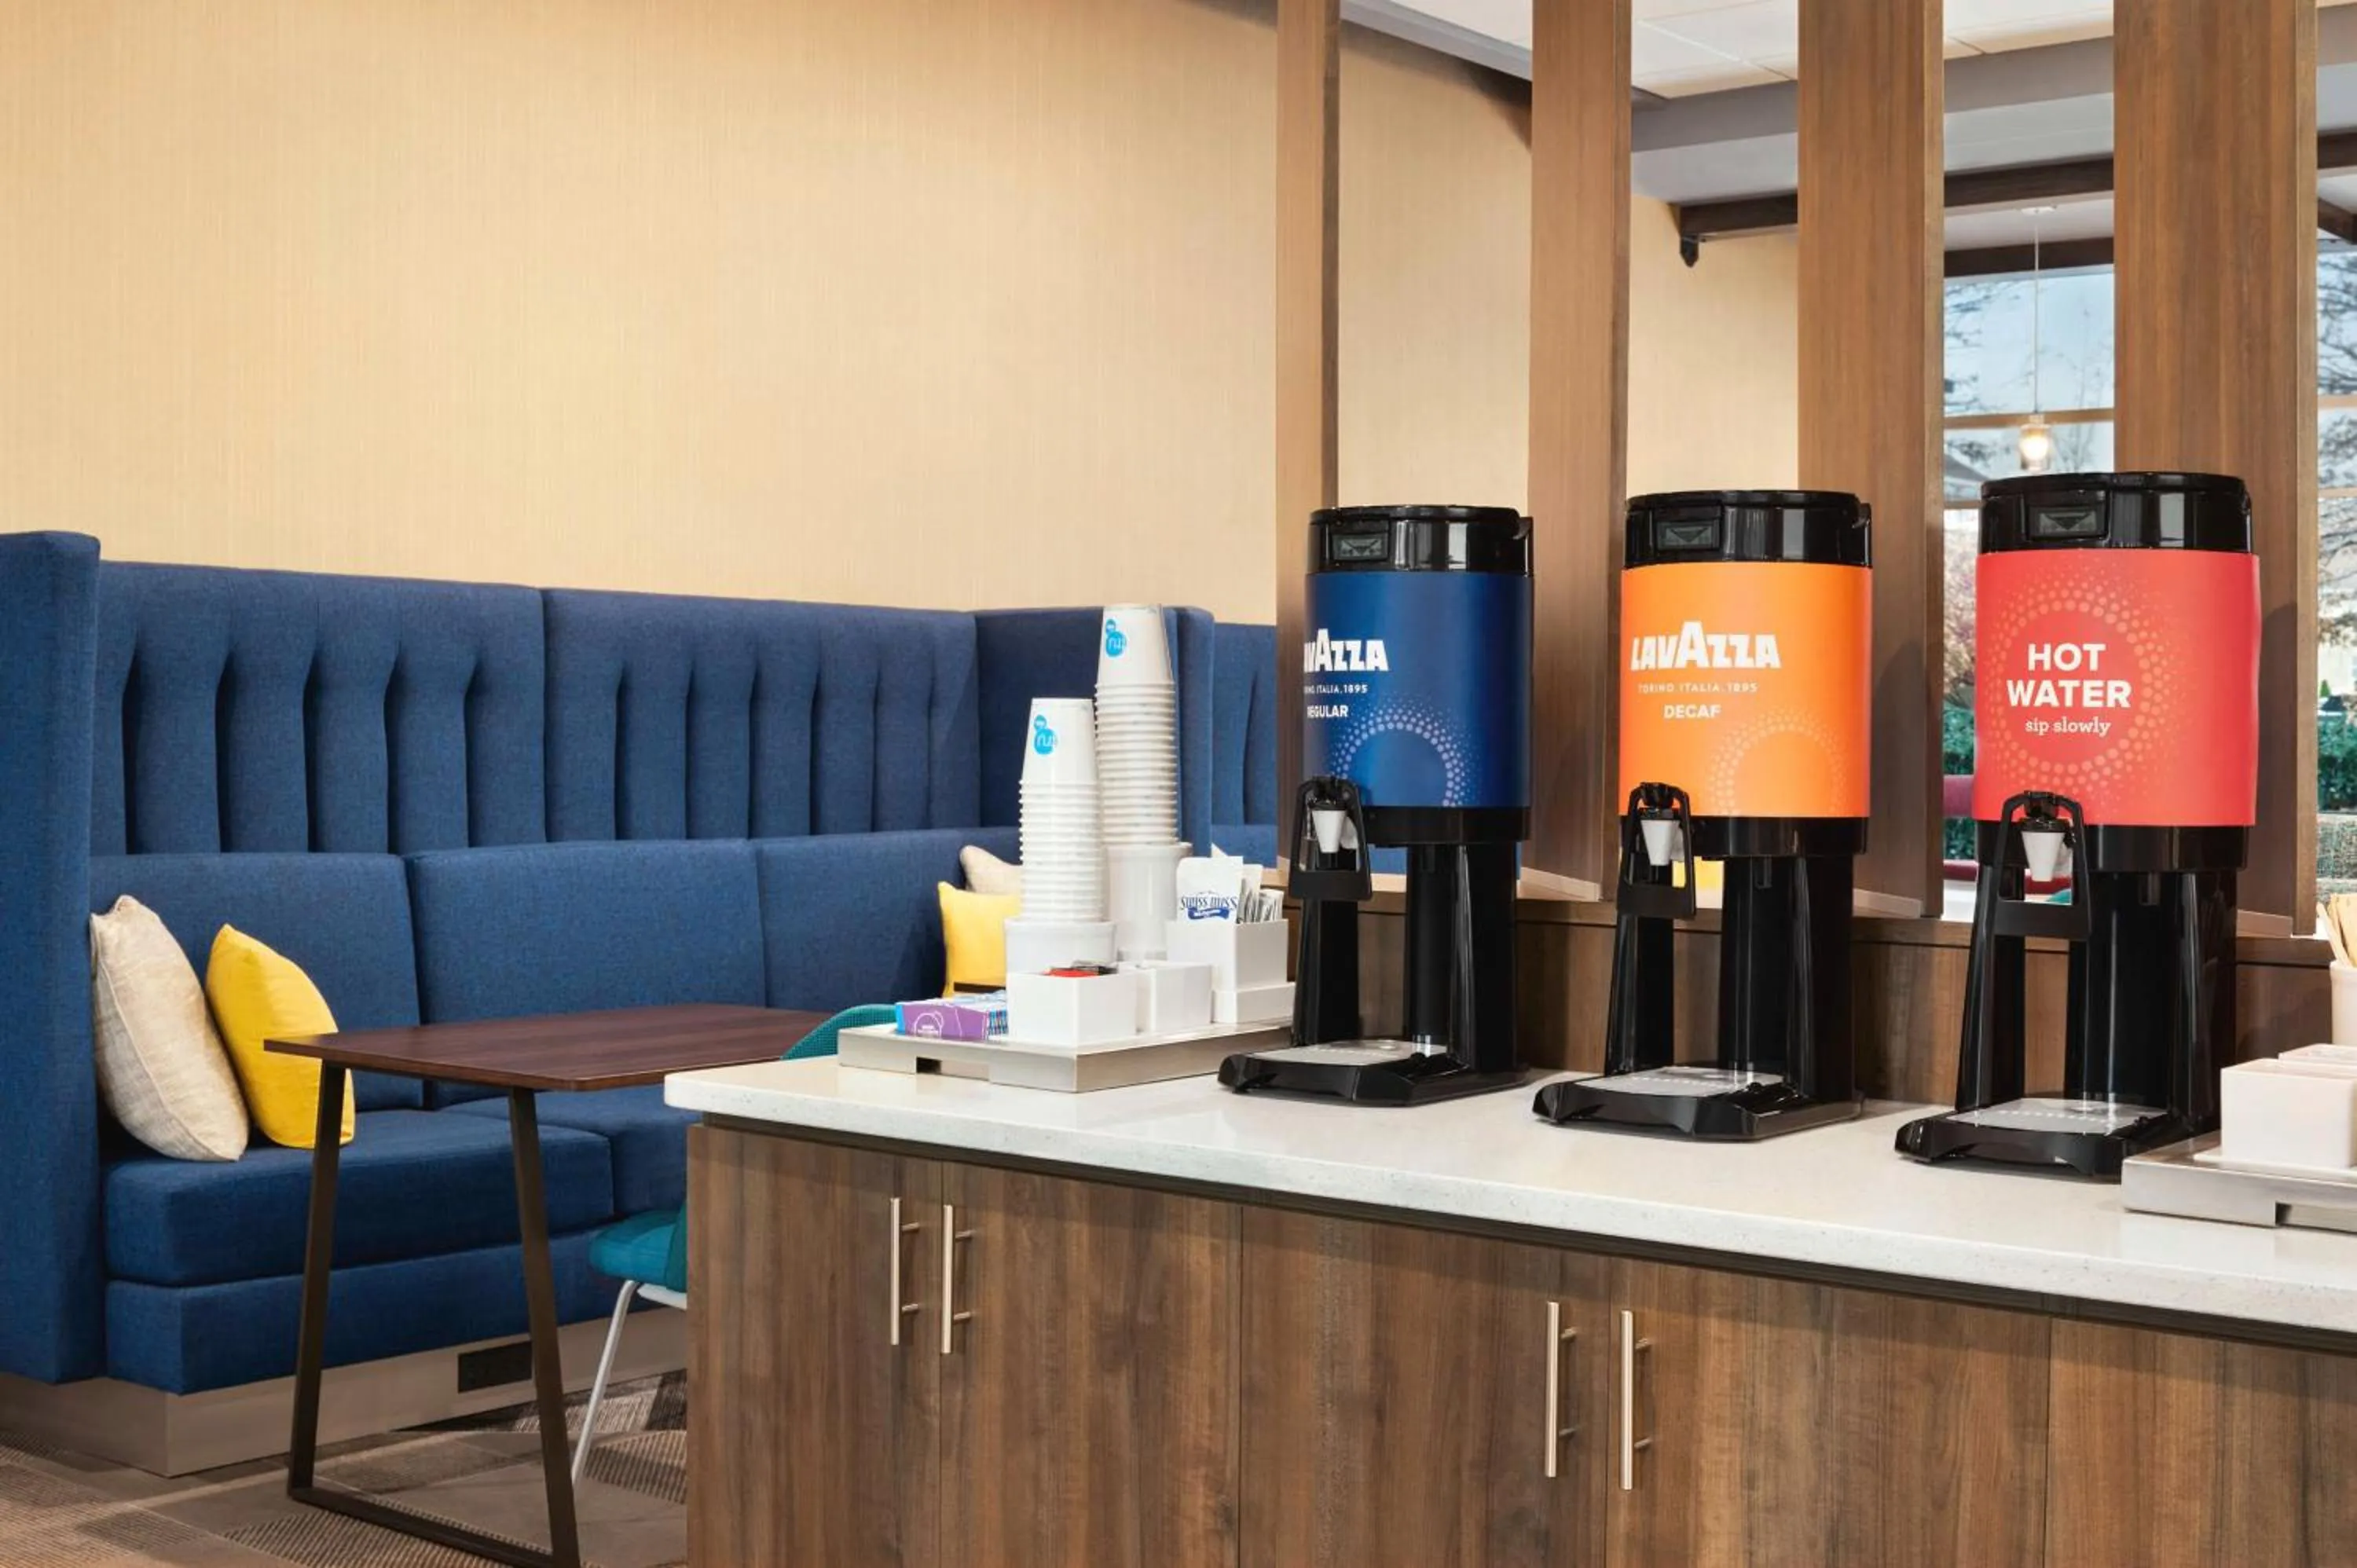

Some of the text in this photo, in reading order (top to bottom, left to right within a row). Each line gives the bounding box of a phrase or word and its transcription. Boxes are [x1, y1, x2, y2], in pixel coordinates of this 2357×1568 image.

[1631, 621, 1782, 671] LAVAZZA
[2028, 643, 2106, 672] HOT
[1343, 684, 1368, 694] 1895
[2007, 680, 2132, 708] WATER
[1663, 704, 1721, 719] DECAF
[2025, 716, 2112, 738] sip slowly
